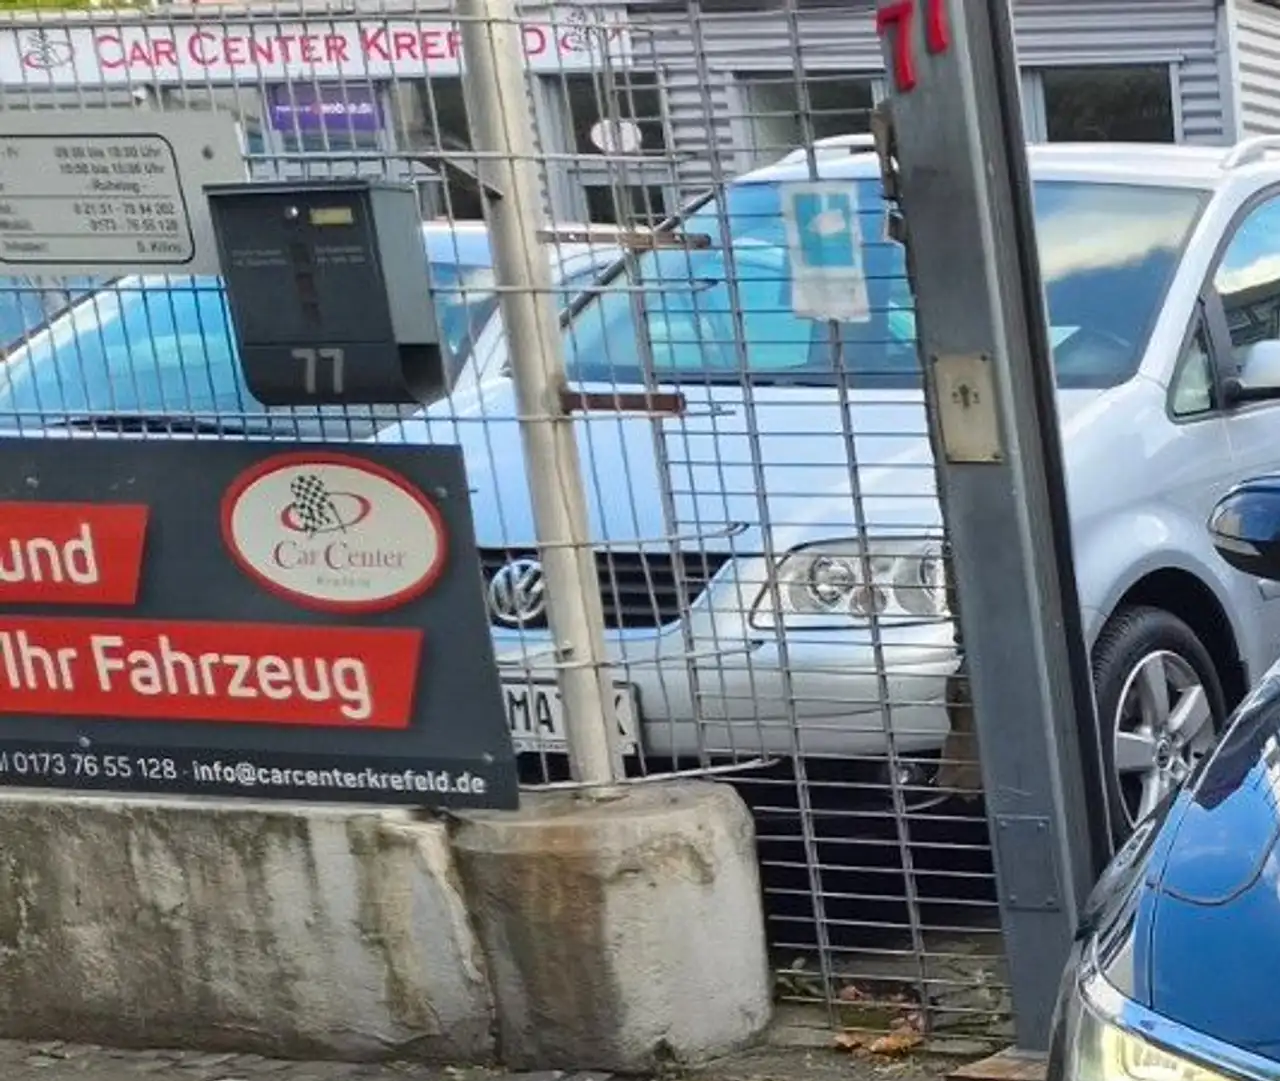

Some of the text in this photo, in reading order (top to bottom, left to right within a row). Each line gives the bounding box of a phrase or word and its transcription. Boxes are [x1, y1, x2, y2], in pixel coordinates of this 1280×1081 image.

[94, 26, 547, 69] CAR CENTER KREFD
[292, 349, 345, 394] 77
[0, 522, 98, 584] und
[273, 538, 406, 570] Car Center
[0, 629, 373, 719] Ihr Fahrzeug
[13, 751, 67, 776] 0173
[70, 753, 100, 777] 76
[102, 755, 132, 778] 55
[136, 756, 178, 780] 128
[191, 760, 486, 794] info@carcenterkrefeld.de
